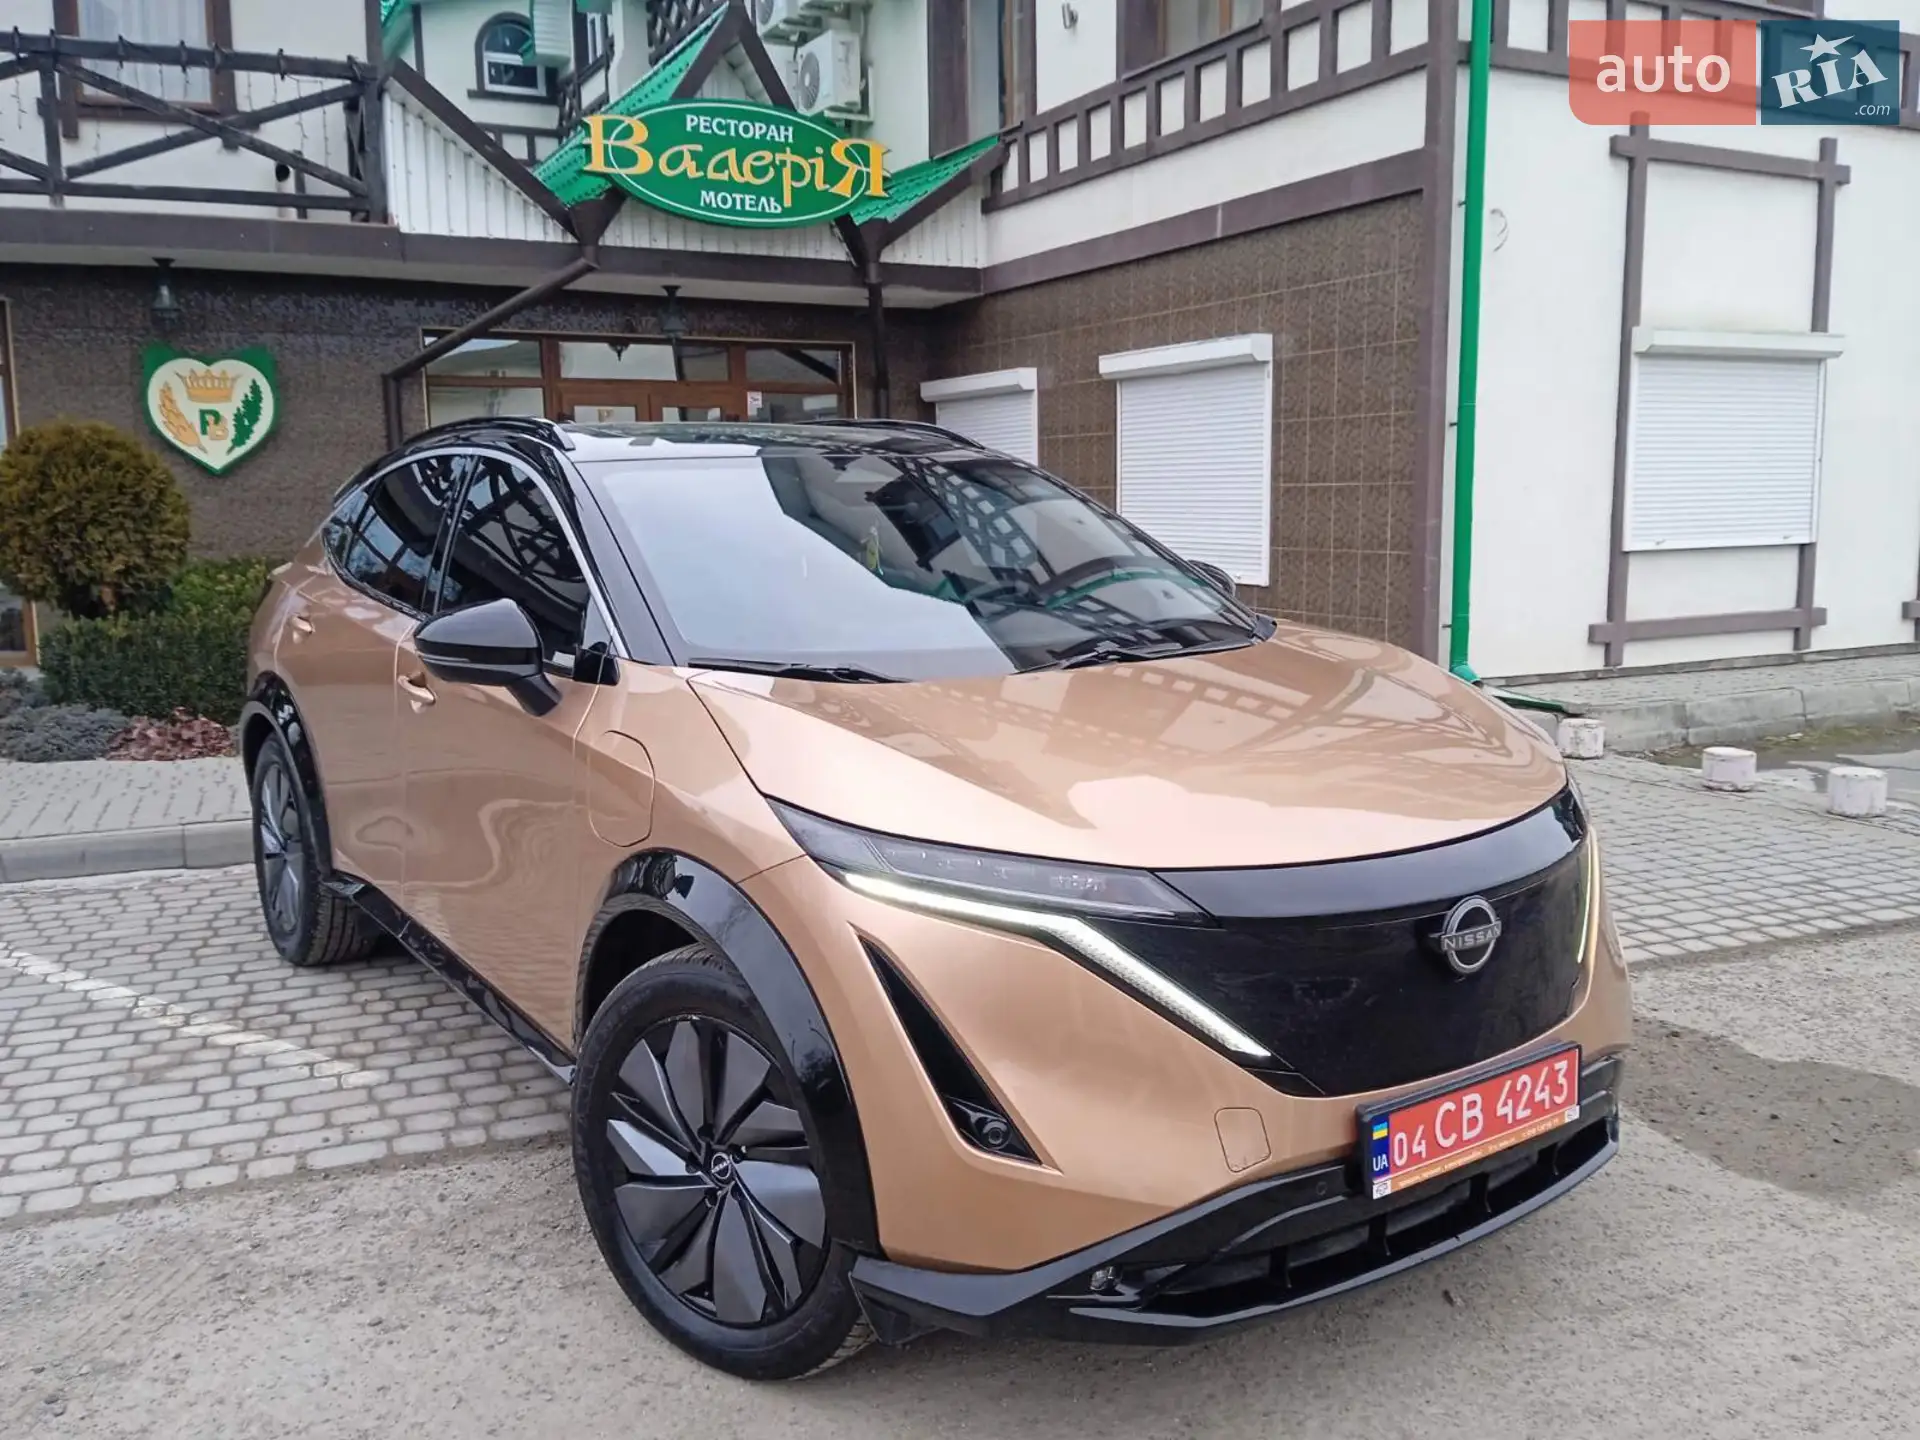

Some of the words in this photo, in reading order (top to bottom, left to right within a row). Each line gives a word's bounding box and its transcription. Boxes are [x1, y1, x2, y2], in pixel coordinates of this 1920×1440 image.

[685, 114, 793, 143] РЕСТОРАН
[700, 190, 782, 213] МОТЕЛЬ
[1444, 925, 1501, 950] NISSAN
[1393, 1124, 1427, 1167] 04
[1496, 1060, 1568, 1124] 4243
[1372, 1154, 1389, 1172] UA
